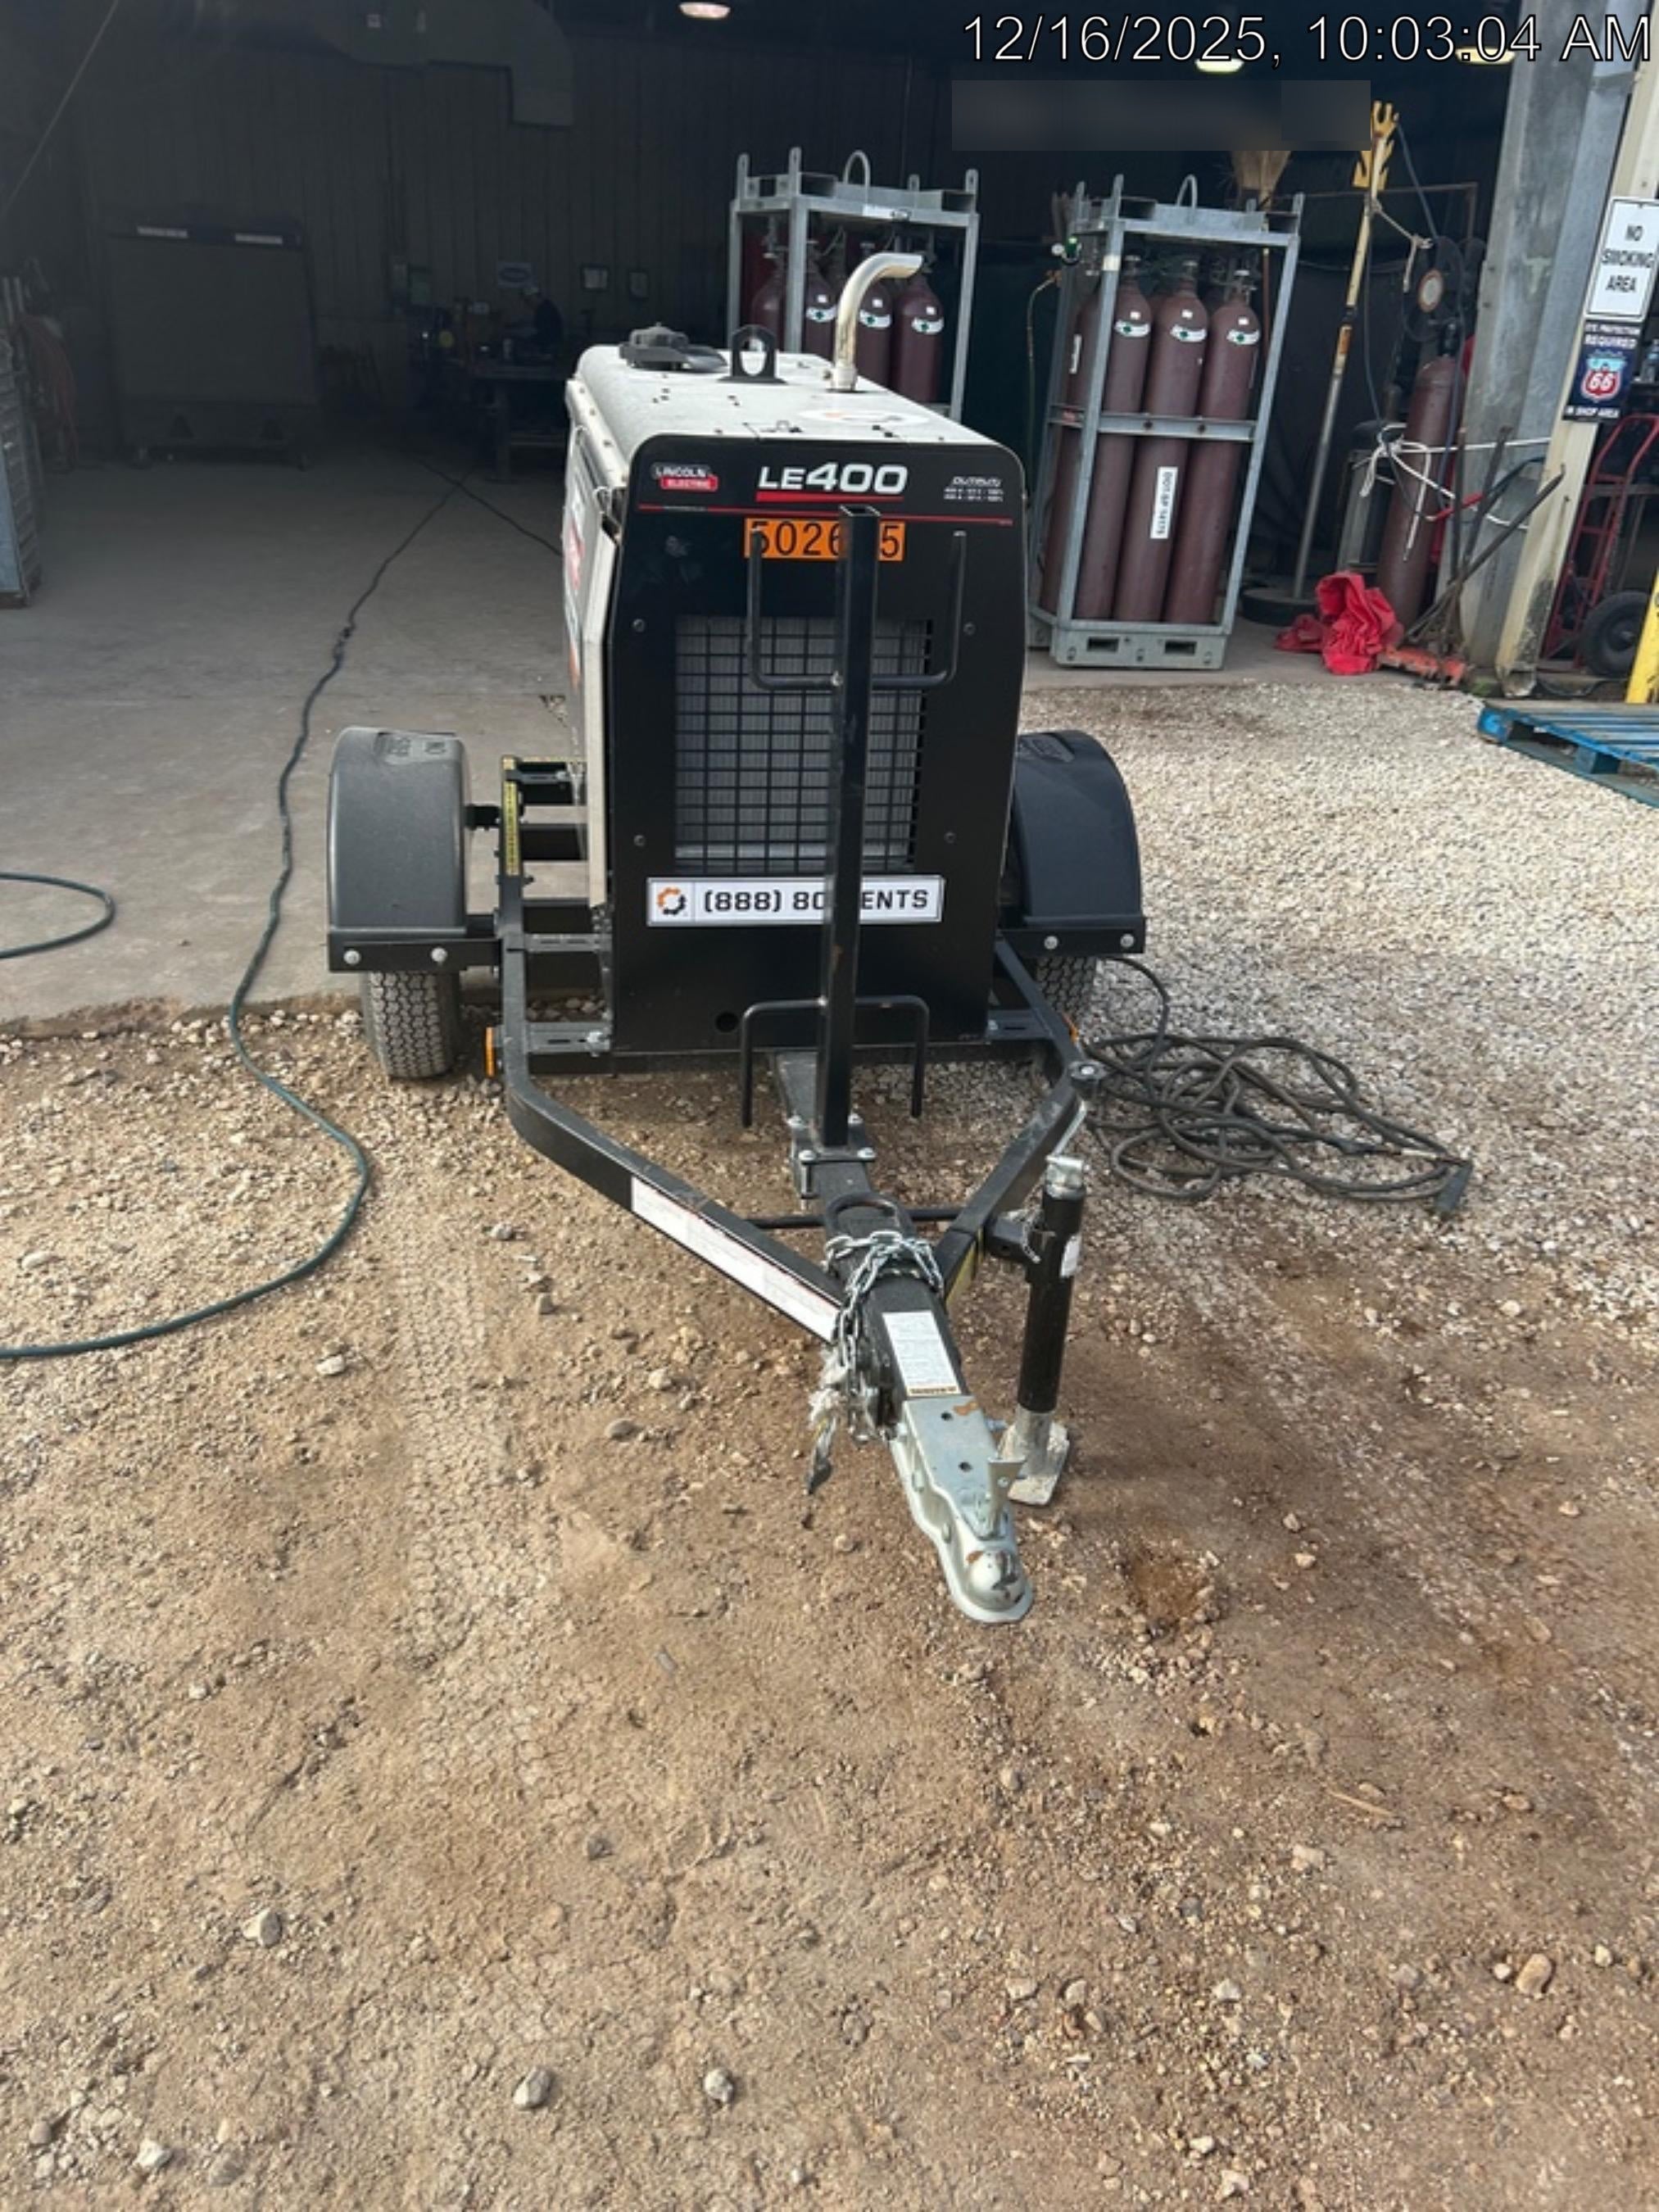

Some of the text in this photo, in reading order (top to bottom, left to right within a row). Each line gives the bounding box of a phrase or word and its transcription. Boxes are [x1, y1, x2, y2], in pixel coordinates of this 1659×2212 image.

[1625, 224, 1643, 242] NO
[1602, 249, 1652, 268] SMOKING
[1606, 274, 1637, 293] AREA
[1588, 373, 1614, 392] 66
[656, 466, 707, 478] LINCOLN
[759, 464, 907, 494] LE400
[752, 521, 900, 557] 50265
[704, 891, 780, 913] (888)
